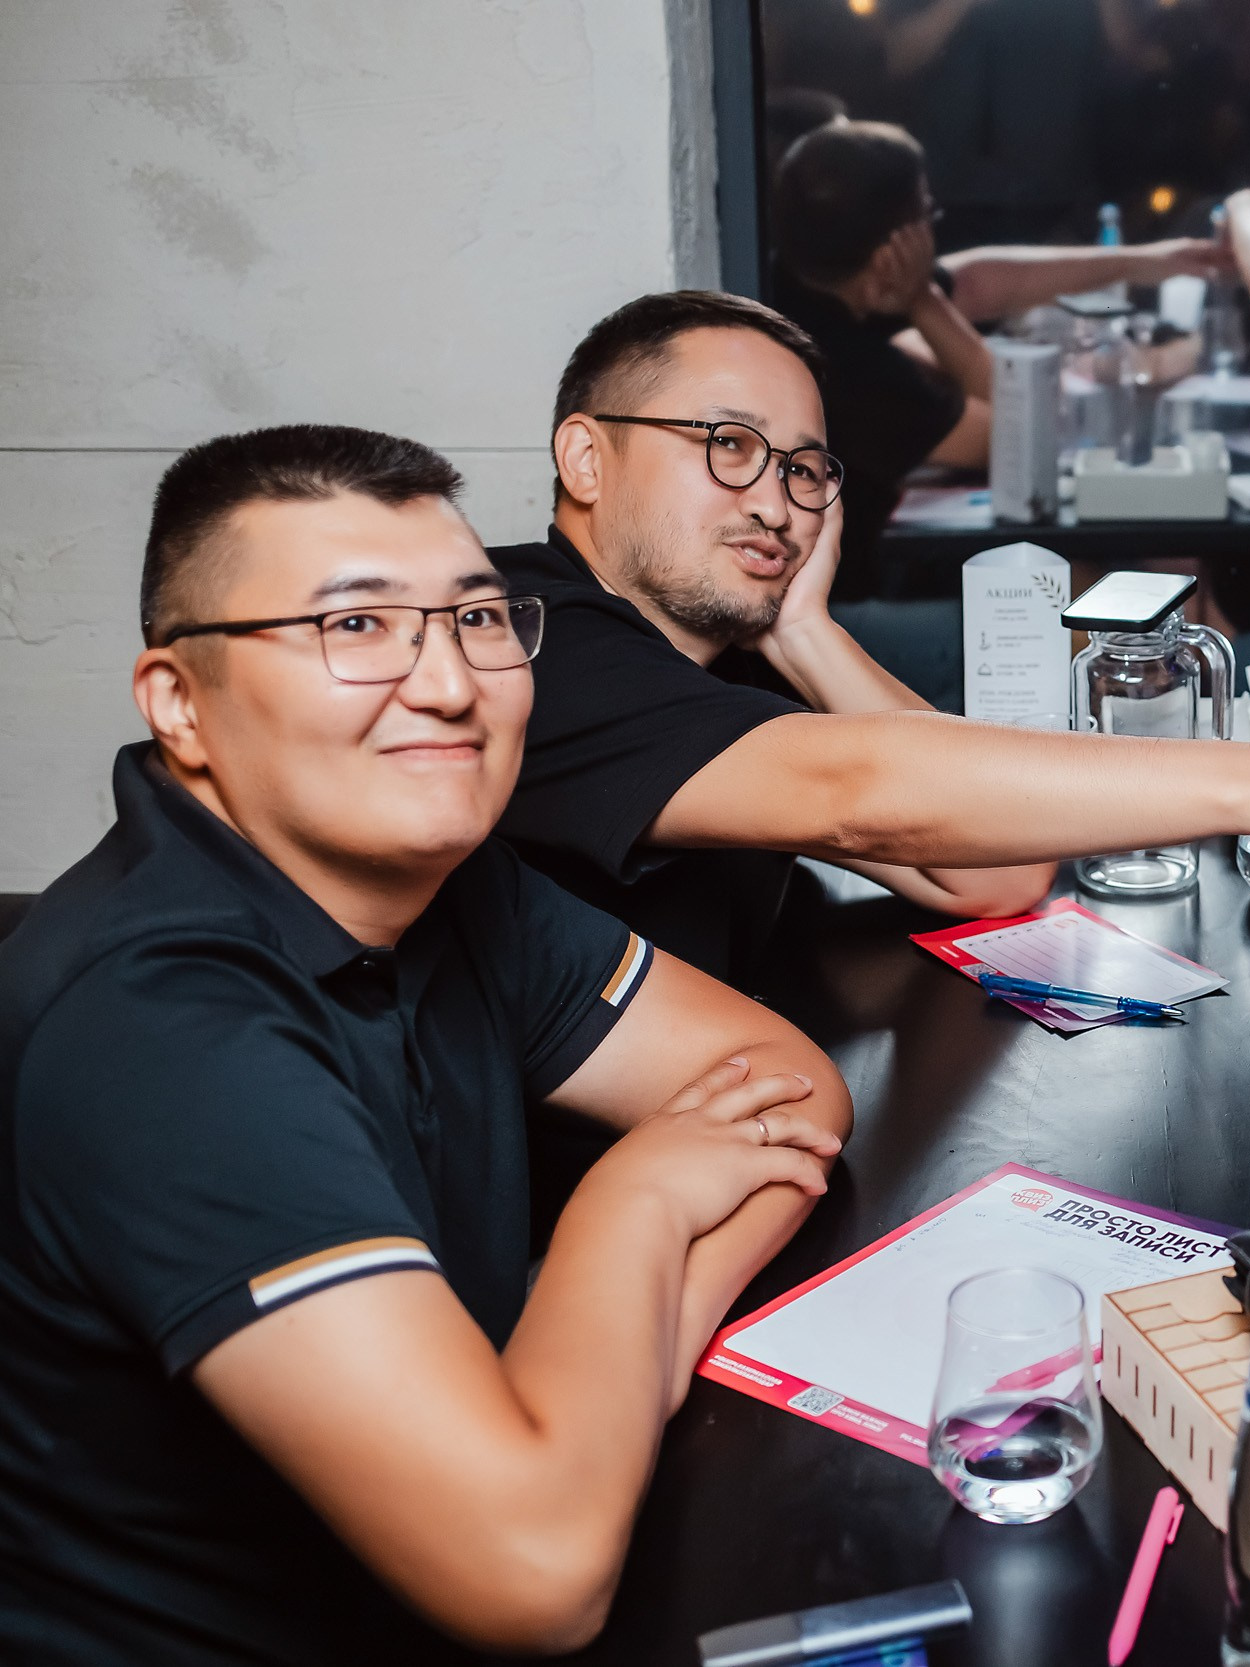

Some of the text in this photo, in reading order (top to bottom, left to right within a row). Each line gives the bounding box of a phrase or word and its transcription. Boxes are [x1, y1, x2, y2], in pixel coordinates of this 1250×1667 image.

[985, 588, 1033, 599] АКЦИИ
[1043, 1208, 1099, 1231] ДЛЯ
[1097, 1225, 1197, 1264] ЗАПИСИ
[1059, 1199, 1157, 1236] ПРОСТО
[1157, 1231, 1227, 1258] ЛИСТ
